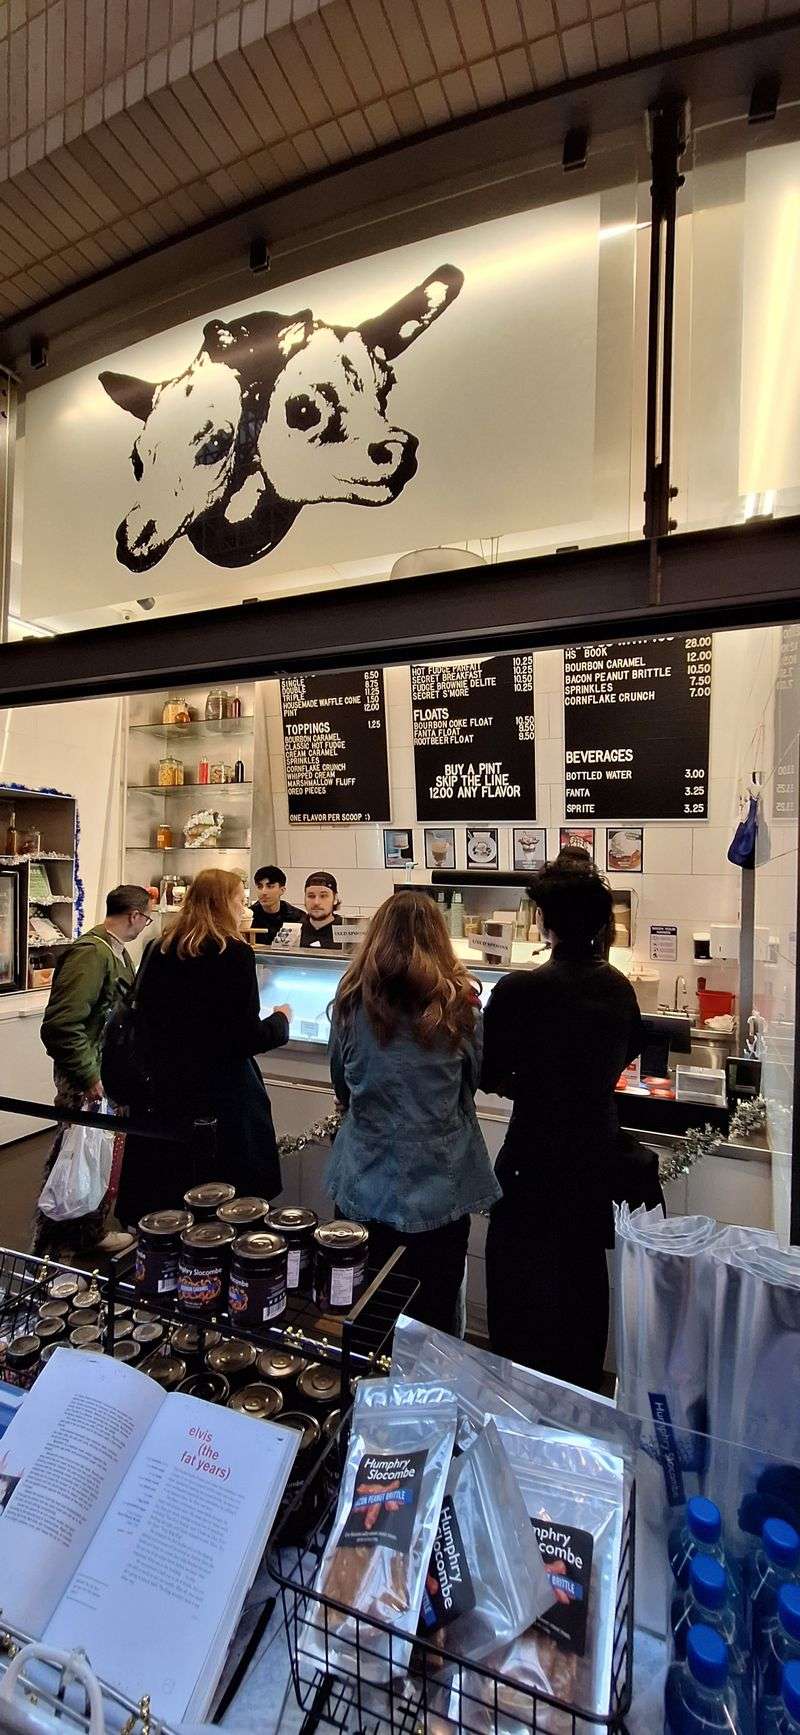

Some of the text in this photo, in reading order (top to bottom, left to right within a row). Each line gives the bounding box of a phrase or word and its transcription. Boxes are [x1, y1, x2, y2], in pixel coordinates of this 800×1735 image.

[685, 637, 711, 648] 28.00
[565, 647, 607, 660] HS BOOK
[687, 651, 712, 662] 12.00
[513, 656, 533, 666] 10.25
[565, 657, 646, 672] BOURBON CARAMEL
[412, 663, 481, 676] HOT FUDGE PARFAIT
[513, 666, 533, 674] 10.25
[687, 664, 711, 674] 10.50
[412, 670, 482, 684] SECRET BREAKFAST
[513, 675, 533, 683] 10.50
[565, 667, 672, 684] BACON PEANUT BRITTLE
[690, 676, 711, 686] 7.50
[281, 679, 305, 687] SINGLE
[413, 677, 496, 692] FUDGE BROWNIE DELITE
[514, 684, 533, 692] 10.25
[565, 682, 613, 695] SPRINKLES
[281, 686, 306, 694] DOUBLE
[412, 688, 469, 700] SECRET S'MORE
[689, 687, 711, 698] 7.00
[282, 693, 305, 702] TRIPLE
[283, 696, 361, 709] HOUSEMADE WAFFLE CONE
[366, 695, 380, 703] 1.50
[565, 691, 655, 706] CORNFLAKE CRUNCH
[284, 709, 297, 717] PINT
[414, 708, 449, 721] FLOATS
[368, 720, 381, 728] 1.25
[414, 717, 493, 730] BOURBON COKE FLOAT
[515, 716, 535, 725] 10.50
[286, 722, 330, 735] TOPPINGS
[414, 728, 460, 738] FANTA FLOAT
[284, 733, 340, 744] BOURBON CARAMEL
[415, 735, 474, 746] ROOTBEER FLOAT
[284, 741, 346, 750] CLASSIC HOT FUDGE
[286, 748, 338, 758] CREAM CARAMEL
[566, 749, 634, 764] BEVERAGES
[286, 757, 320, 765] SPRINKLES
[287, 763, 346, 773] CORNFLAKE CRUNCH
[445, 762, 502, 776] BUY A PINT
[684, 769, 705, 778] 3.00
[287, 772, 312, 780] WHIPPED
[436, 774, 509, 787] SKIP THE LINE
[566, 770, 632, 780] BOTTLED WATER
[288, 778, 357, 787] MARSHMALLOW FLUFF
[305, 787, 326, 795] PIECES
[458, 787, 478, 798] ANY
[482, 785, 521, 798] FLAVOR
[566, 788, 590, 797] FANTA
[685, 786, 705, 796] 3.25
[566, 804, 595, 813] SPRITE
[683, 803, 704, 813] 3.25
[189, 1427, 213, 1442] elvis
[198, 1442, 219, 1460] (the
[181, 1451, 196, 1466] fat
[196, 1459, 230, 1481] years)
[364, 1458, 410, 1471] Humphry
[368, 1468, 415, 1480] Slocombe
[532, 1526, 570, 1547] mphry
[441, 1507, 463, 1582] Humphry
[539, 1542, 583, 1569] combe
